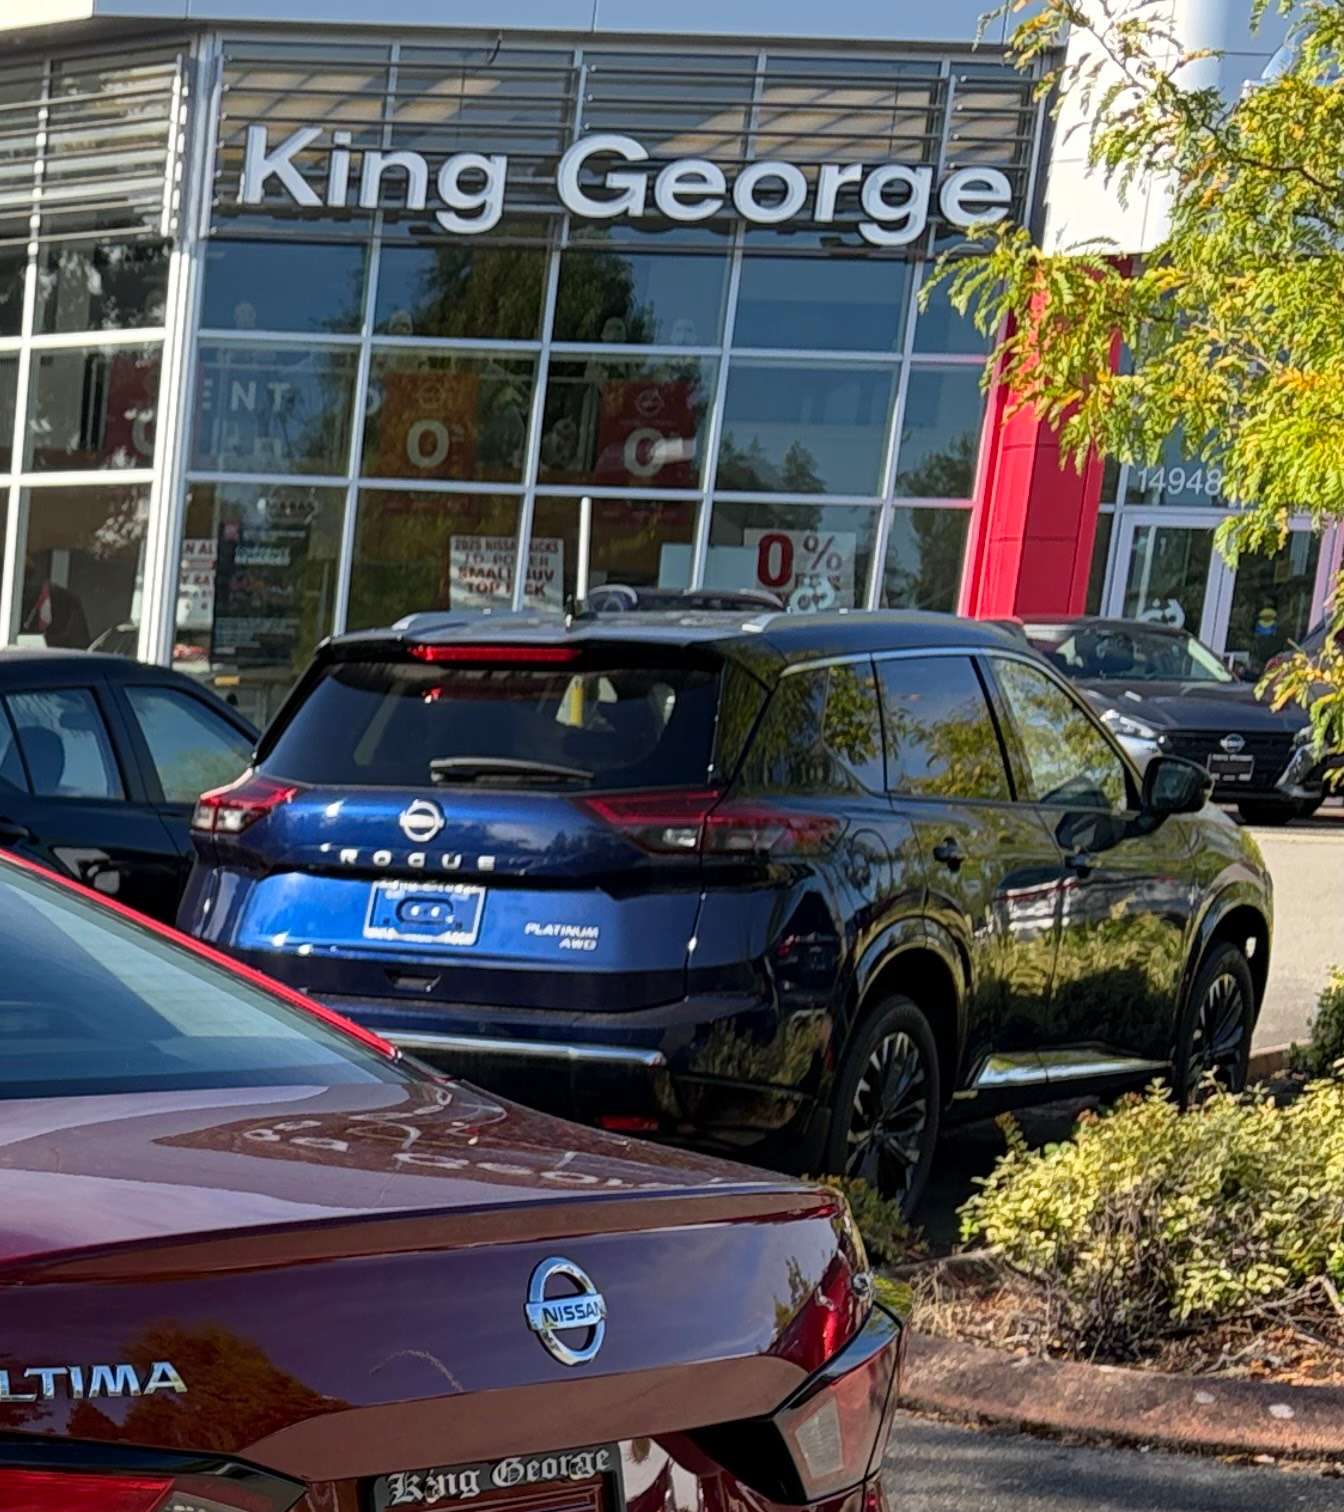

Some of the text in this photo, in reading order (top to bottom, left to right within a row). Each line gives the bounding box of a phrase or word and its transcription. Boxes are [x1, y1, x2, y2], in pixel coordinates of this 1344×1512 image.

[243, 123, 1013, 246] King George
[1137, 466, 1222, 496] 14948
[485, 539, 519, 553] NISSA
[339, 848, 496, 872] ROGUE
[524, 922, 599, 938] PLATINUM
[558, 937, 598, 950] AWD
[386, 1448, 611, 1505] King George
